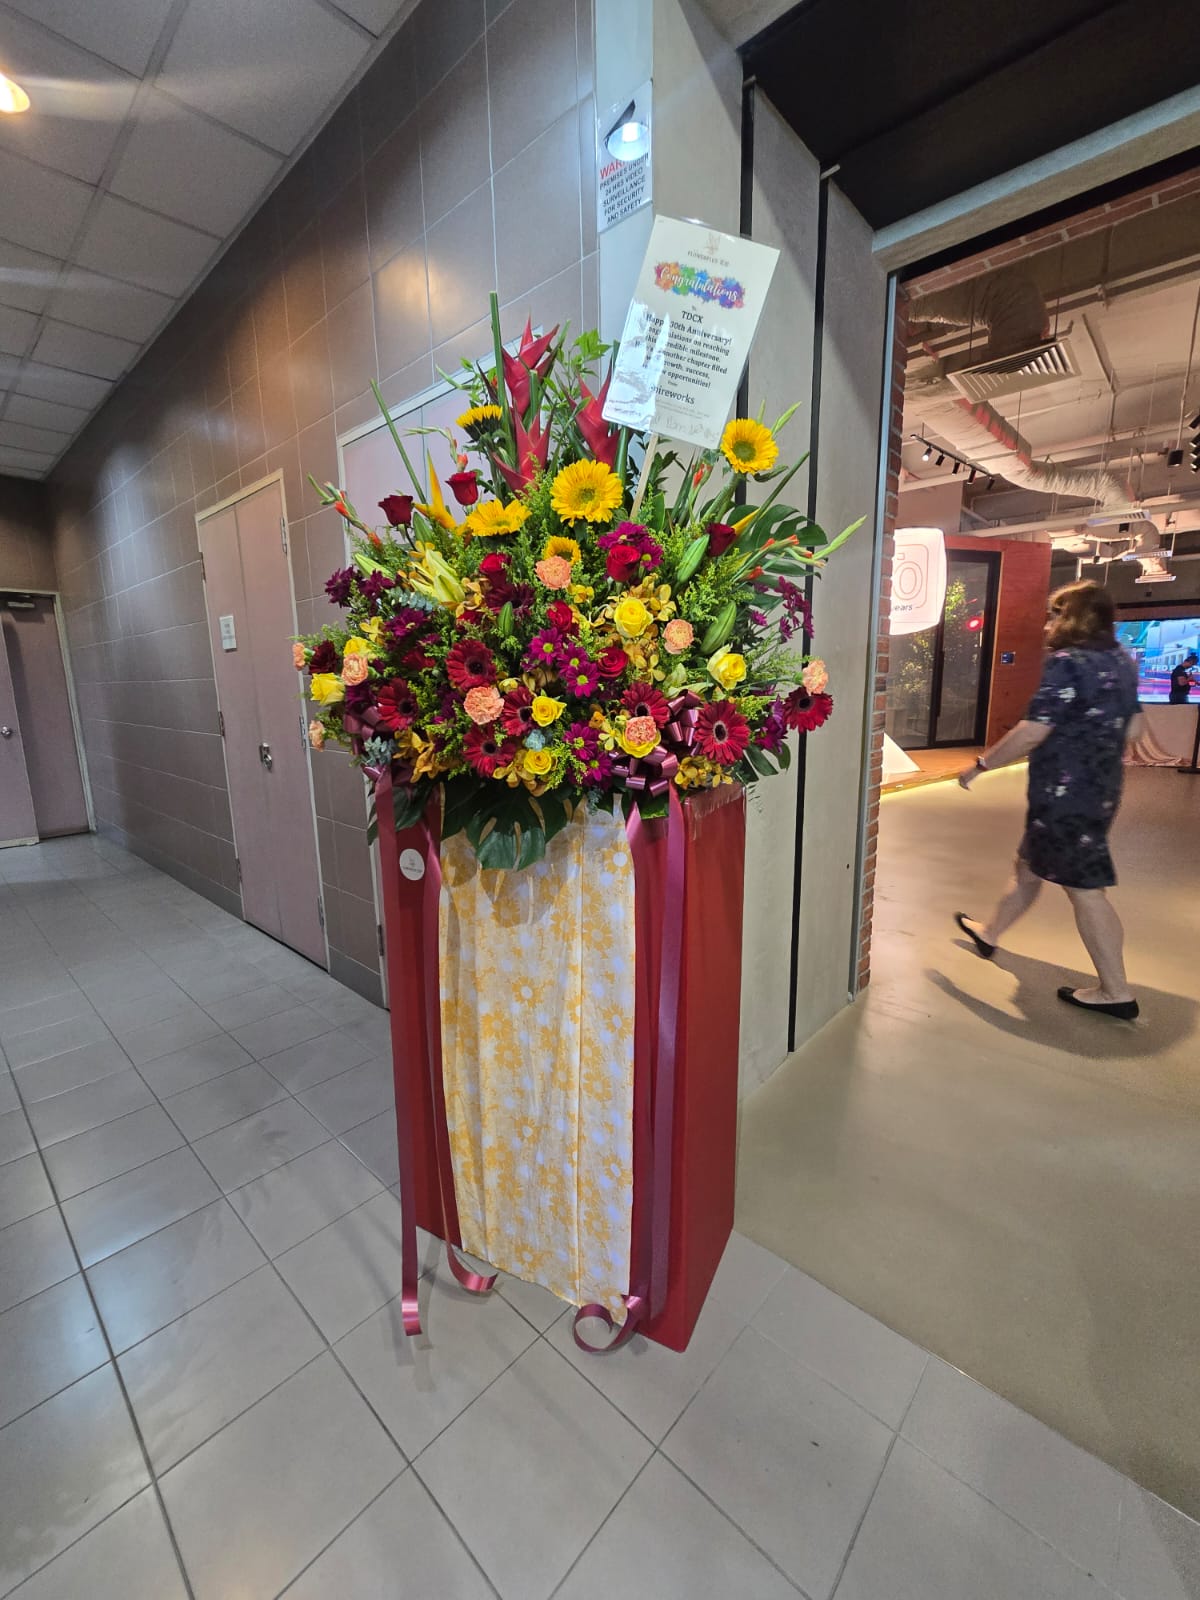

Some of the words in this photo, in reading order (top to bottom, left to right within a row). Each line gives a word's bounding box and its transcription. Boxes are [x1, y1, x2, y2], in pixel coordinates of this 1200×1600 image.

[600, 167, 628, 190] PREMISES
[625, 167, 643, 183] VIDEO
[603, 175, 646, 207] SURVEILLANCE
[604, 204, 616, 216] FOR
[617, 186, 644, 208] SECURITY
[607, 213, 619, 223] AND
[620, 197, 642, 215] SAFETY
[660, 266, 738, 302] Congratulations
[681, 310, 704, 324] TDCX
[646, 312, 665, 327] Happ
[670, 320, 686, 332] 30th
[687, 325, 732, 345] Anniversary!
[703, 342, 730, 356] reaching
[663, 360, 683, 371] rowth,
[687, 356, 710, 370] chapter
[667, 370, 711, 388] opportunities!
[893, 603, 912, 611] ears
